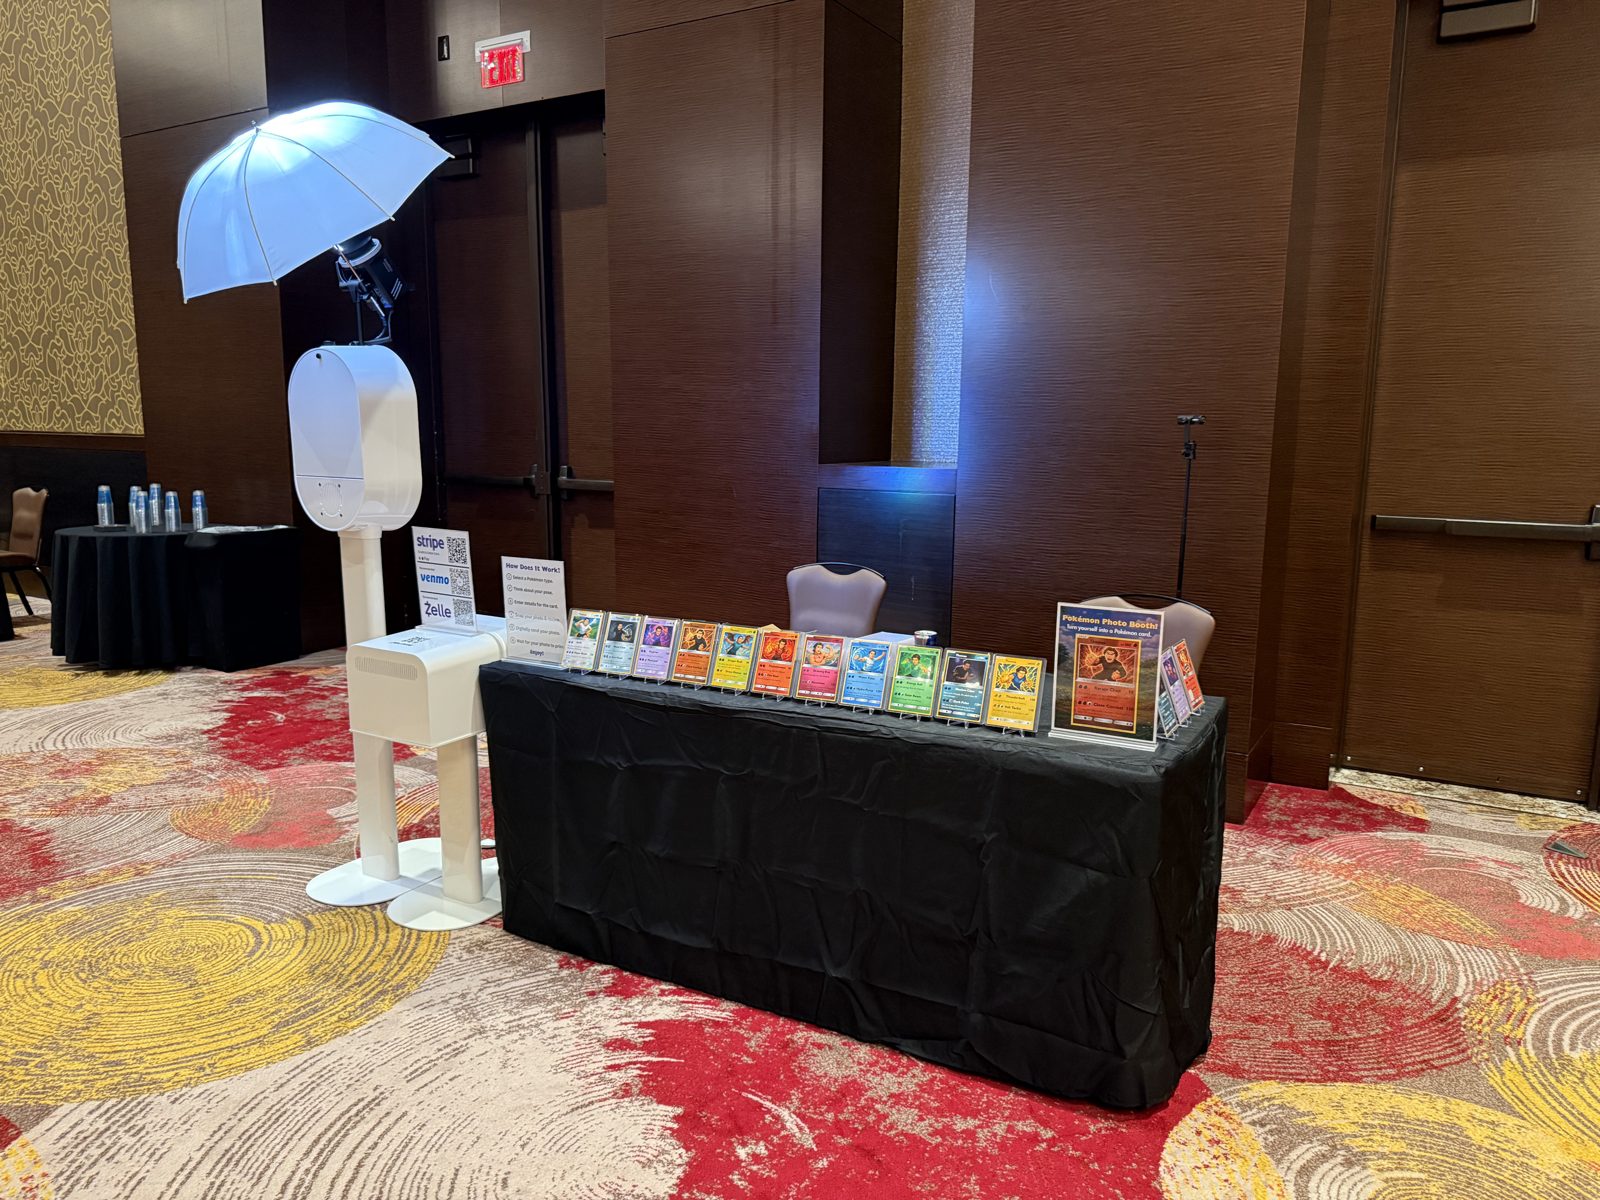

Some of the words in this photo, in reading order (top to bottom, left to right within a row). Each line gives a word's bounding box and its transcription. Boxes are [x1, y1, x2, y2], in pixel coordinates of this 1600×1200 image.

[417, 535, 444, 551] stripe
[420, 573, 449, 585] venmo
[424, 601, 451, 618] Zelle
[1062, 614, 1100, 624] Pokémon
[1102, 618, 1127, 627] Photo
[1129, 620, 1158, 630] Booth!
